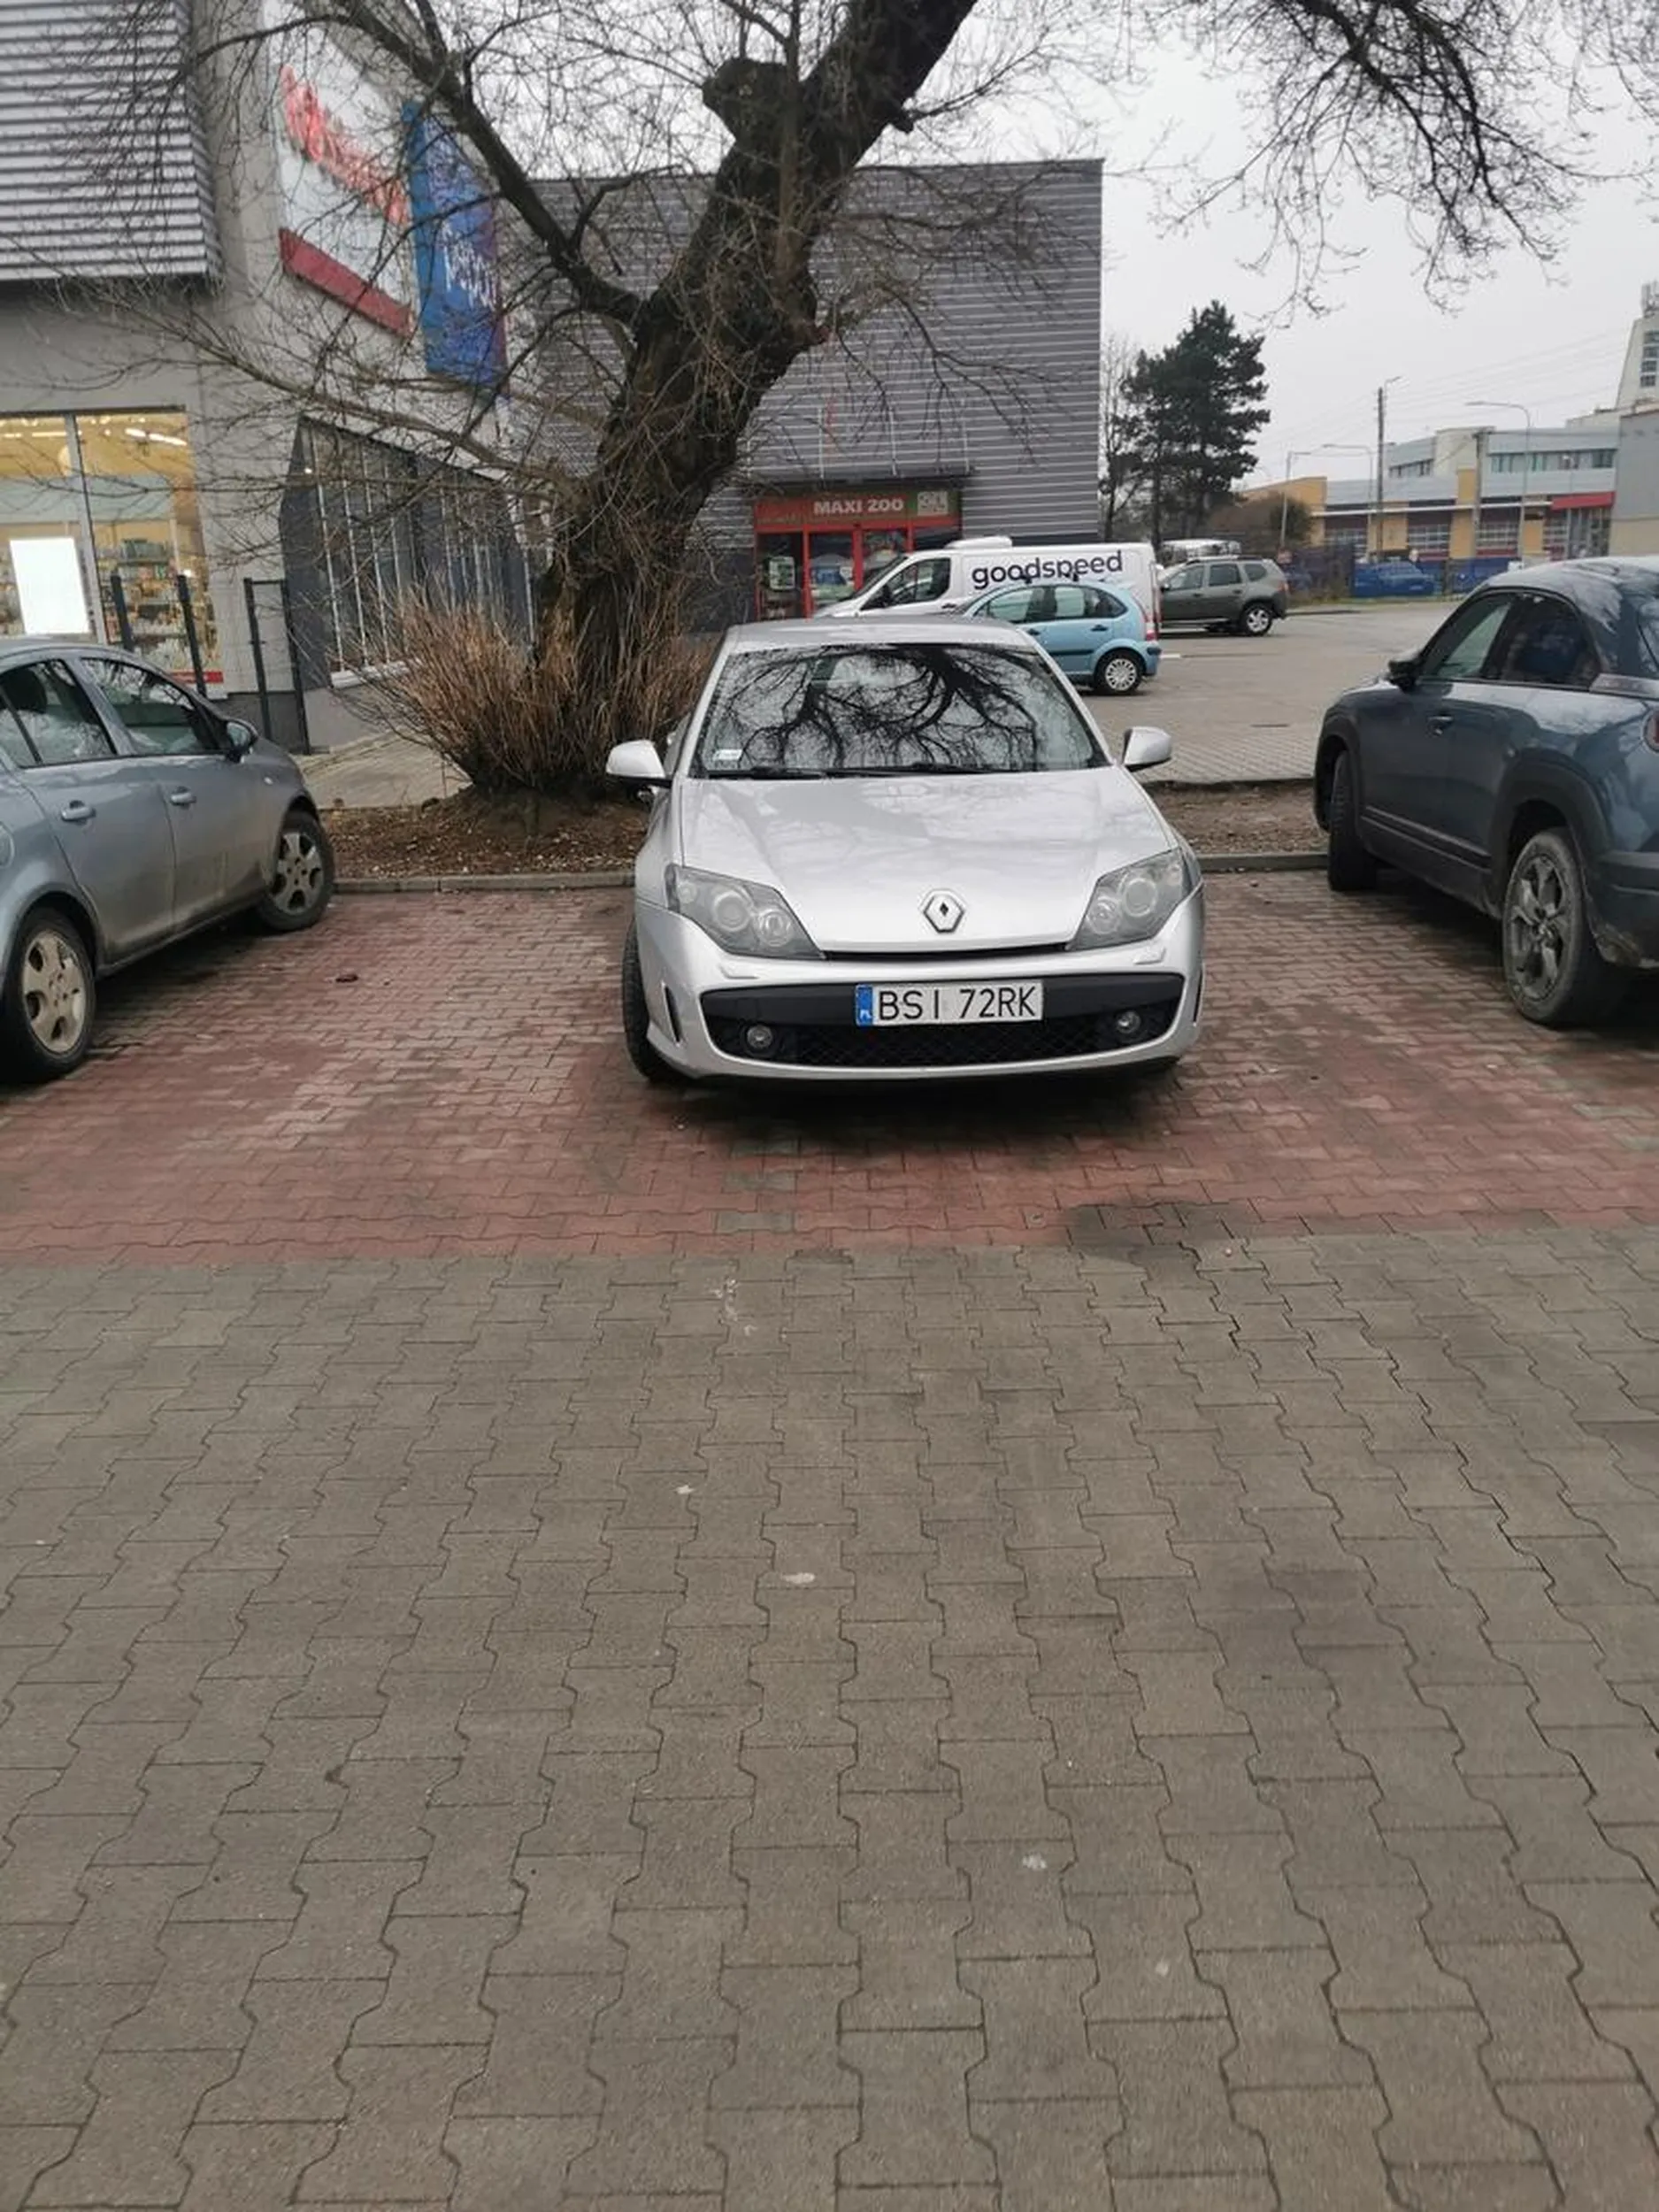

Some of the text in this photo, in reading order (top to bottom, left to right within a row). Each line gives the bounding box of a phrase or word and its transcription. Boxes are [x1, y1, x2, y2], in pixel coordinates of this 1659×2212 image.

[813, 497, 904, 515] MAXI ZOO
[972, 549, 1123, 590] goodspeed
[879, 986, 1036, 1020] BSI 72RK
